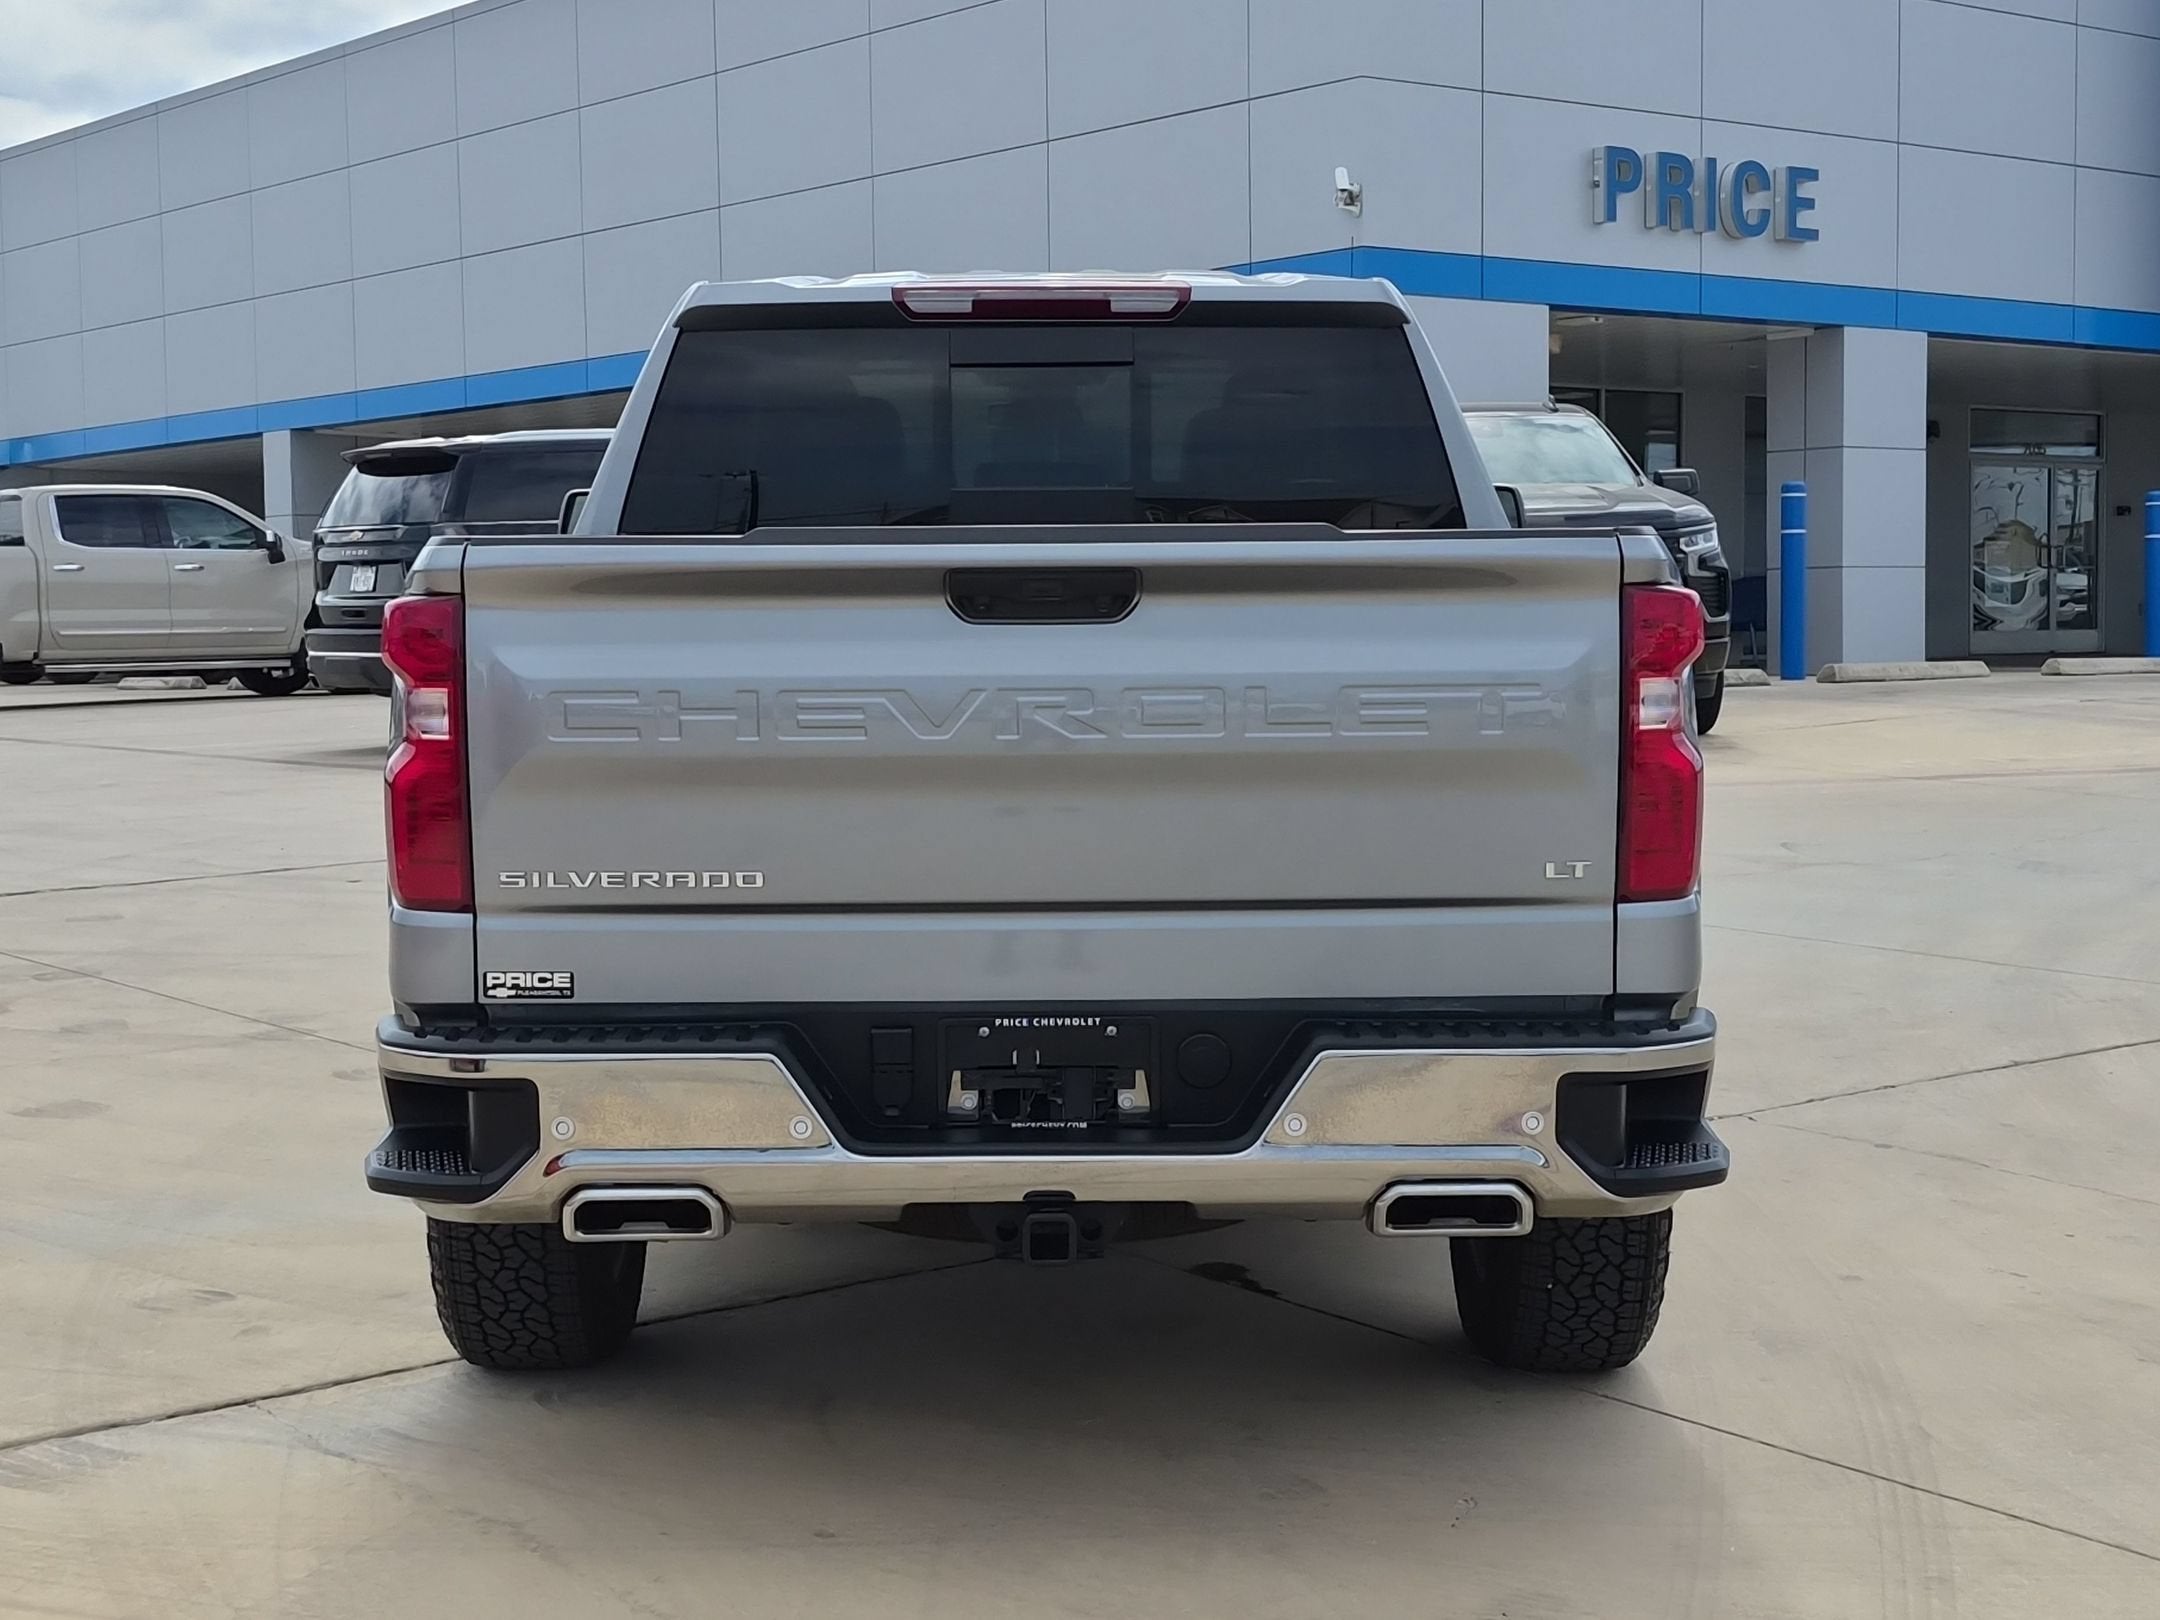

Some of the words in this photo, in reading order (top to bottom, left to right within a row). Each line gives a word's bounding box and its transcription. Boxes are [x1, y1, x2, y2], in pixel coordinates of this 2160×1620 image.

[1593, 145, 1819, 242] PRICE
[547, 683, 1543, 741] CHEVROLET
[1545, 860, 1592, 879] LT
[499, 871, 765, 889] SILVERADO
[486, 972, 571, 988] PRICE
[994, 1018, 1029, 1027] PRICE
[1033, 1017, 1101, 1027] CHEVROLET
